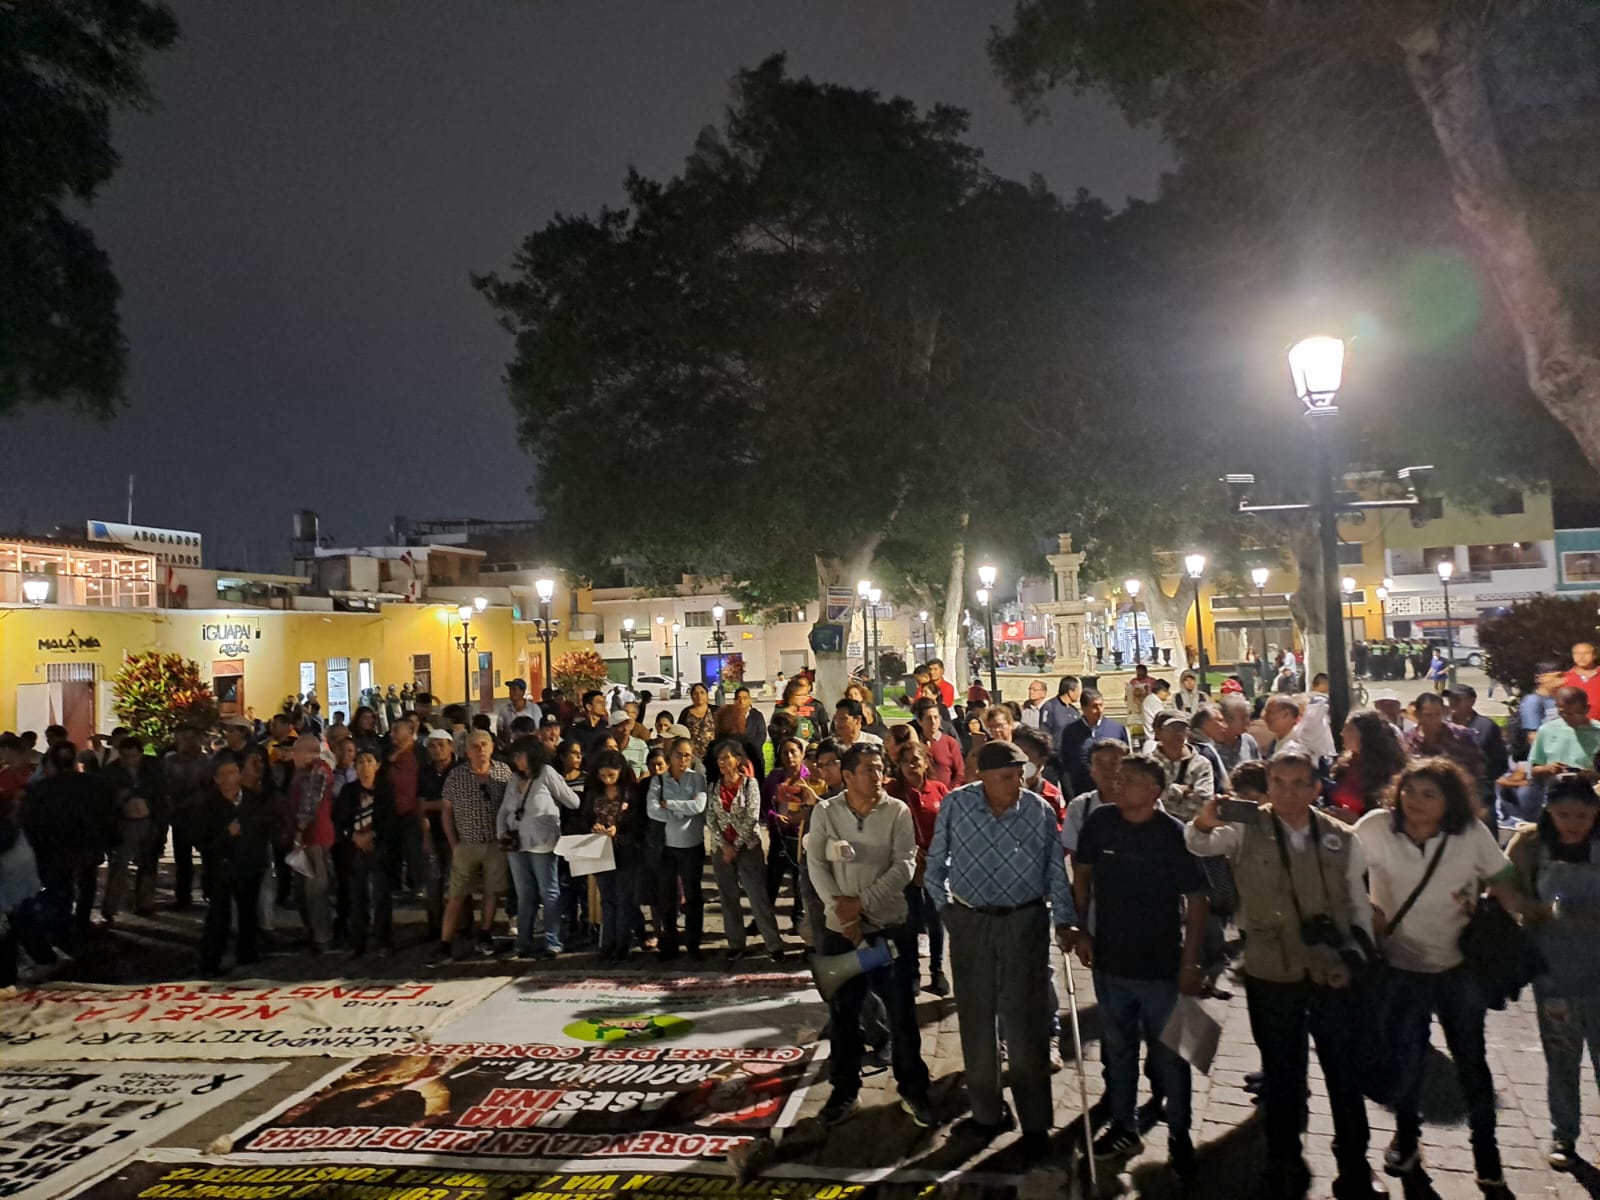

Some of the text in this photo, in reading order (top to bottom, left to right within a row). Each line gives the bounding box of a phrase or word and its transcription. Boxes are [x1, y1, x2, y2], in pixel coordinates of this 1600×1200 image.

[133, 530, 199, 547] ABOGADOS
[156, 553, 199, 565] CIADOS
[38, 638, 77, 650] MALA
[342, 1000, 398, 1008] una
[74, 1005, 288, 1022] NUEVA
[590, 1047, 664, 1061] DEL
[668, 1047, 803, 1061] CIERRE
[90, 1084, 181, 1096] ROSTROS
[480, 1087, 679, 1112] ASESINA
[455, 1106, 578, 1129] DINA
[246, 1126, 379, 1151] LUCHA
[366, 1126, 430, 1150] DE
[415, 1128, 494, 1153] PIE
[481, 1130, 549, 1156] EN
[559, 1175, 620, 1190] VIA
